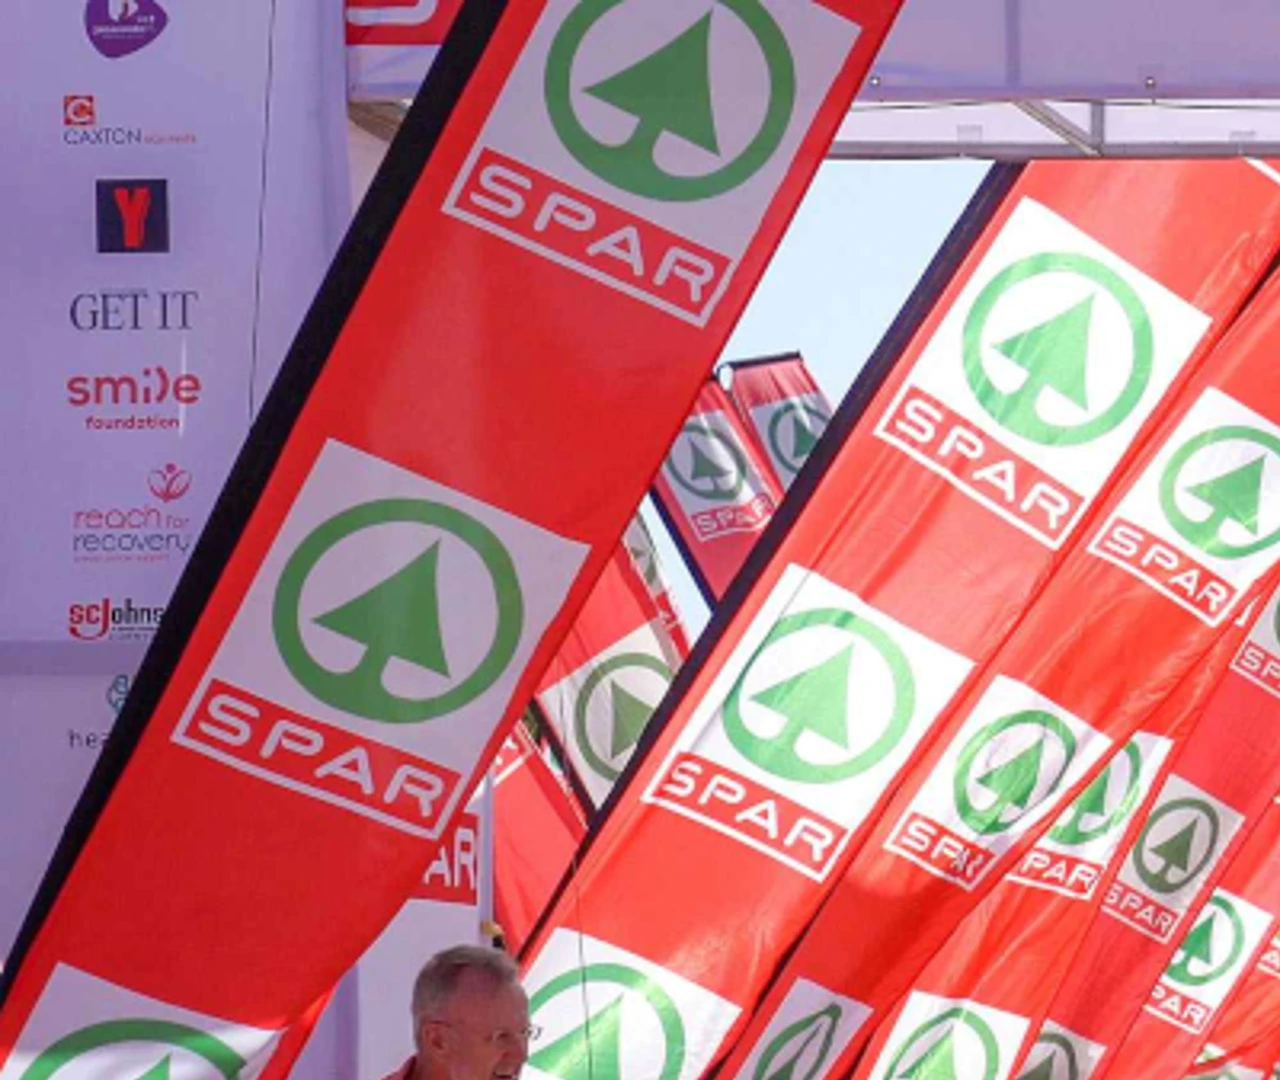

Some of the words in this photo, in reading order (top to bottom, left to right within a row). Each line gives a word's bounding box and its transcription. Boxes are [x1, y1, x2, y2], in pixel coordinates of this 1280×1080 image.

[63, 128, 141, 145] CAXTON
[114, 187, 151, 248] Y
[469, 163, 715, 305] SPAR
[70, 292, 149, 332] GET
[154, 292, 198, 332] IT
[85, 415, 180, 431] foundation
[896, 399, 1071, 530] SPAR
[73, 533, 190, 553] recovery
[74, 504, 161, 529] reach
[1105, 525, 1228, 617] SPAR
[199, 693, 444, 817] SPAR
[664, 761, 836, 863] SPAR
[422, 826, 476, 889] AR
[1021, 855, 1097, 888] PAR
